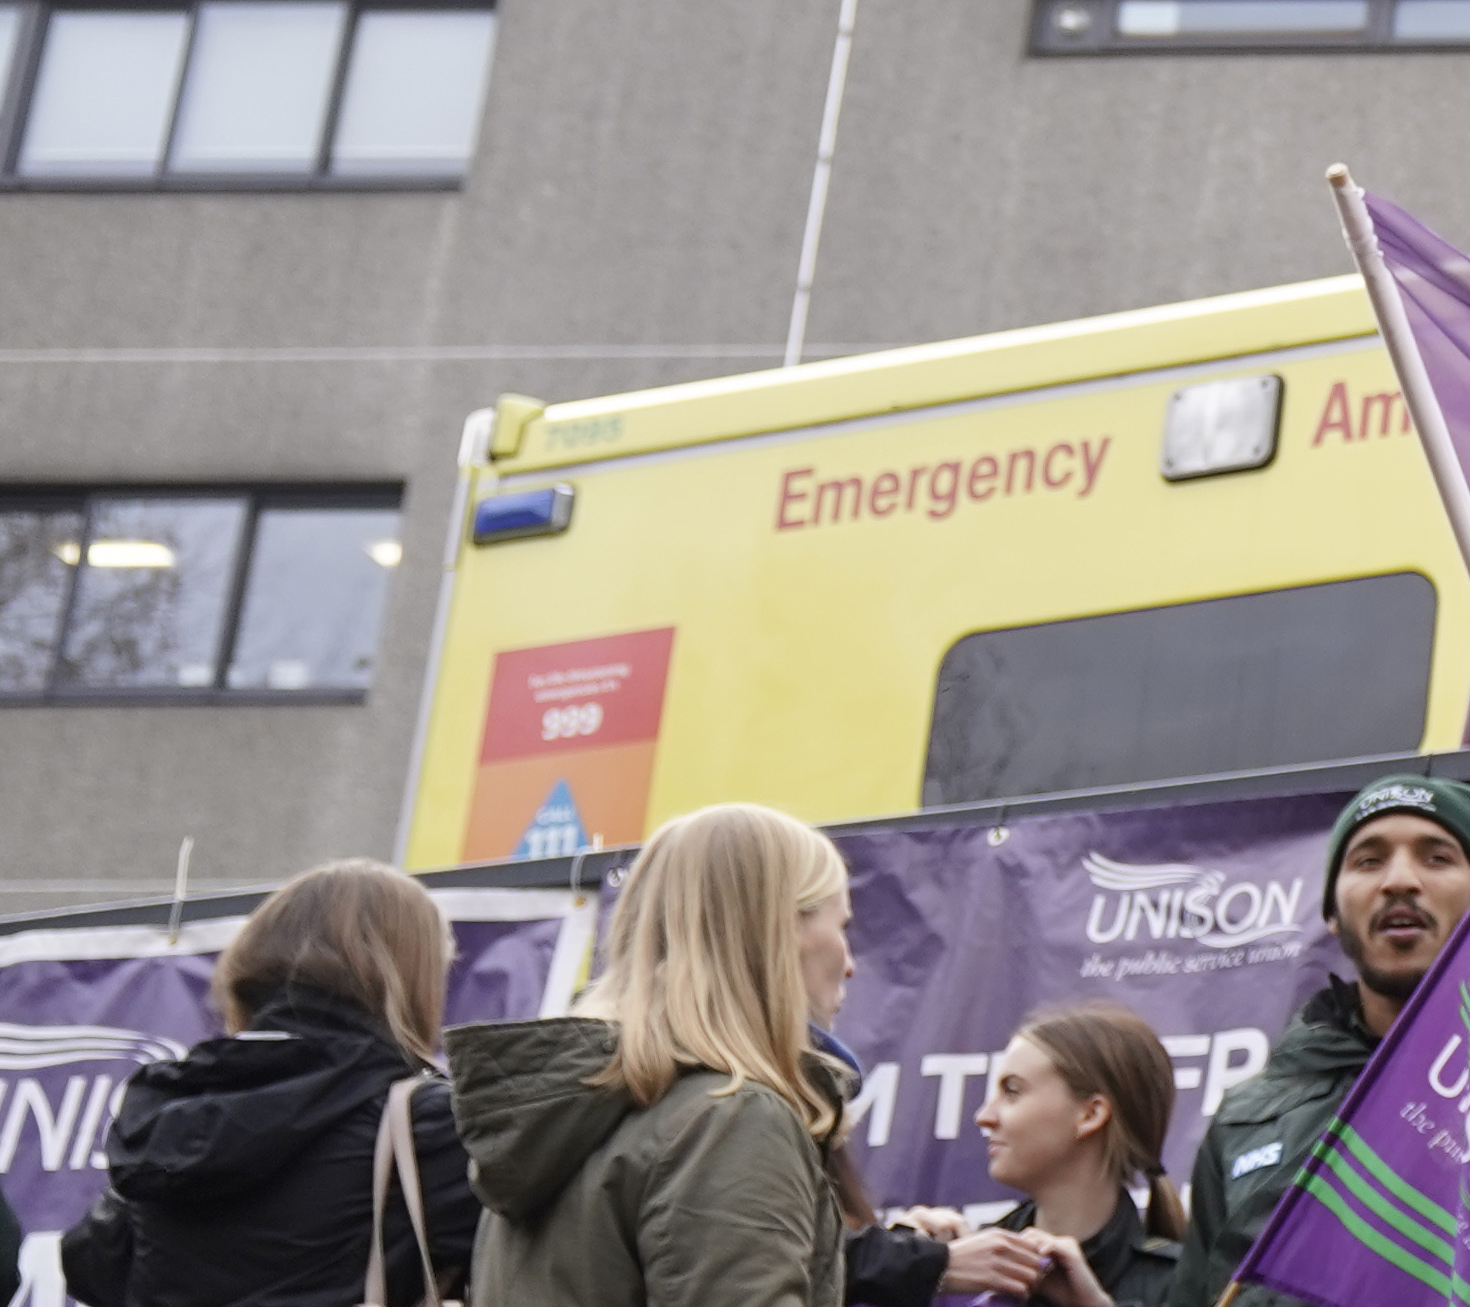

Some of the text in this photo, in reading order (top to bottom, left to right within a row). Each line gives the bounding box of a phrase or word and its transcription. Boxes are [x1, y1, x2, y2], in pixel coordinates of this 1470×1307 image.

[776, 436, 1113, 532] Emergency
[541, 702, 603, 741] 999
[1086, 877, 1304, 943] UNISON
[1080, 942, 1304, 981] the public service union
